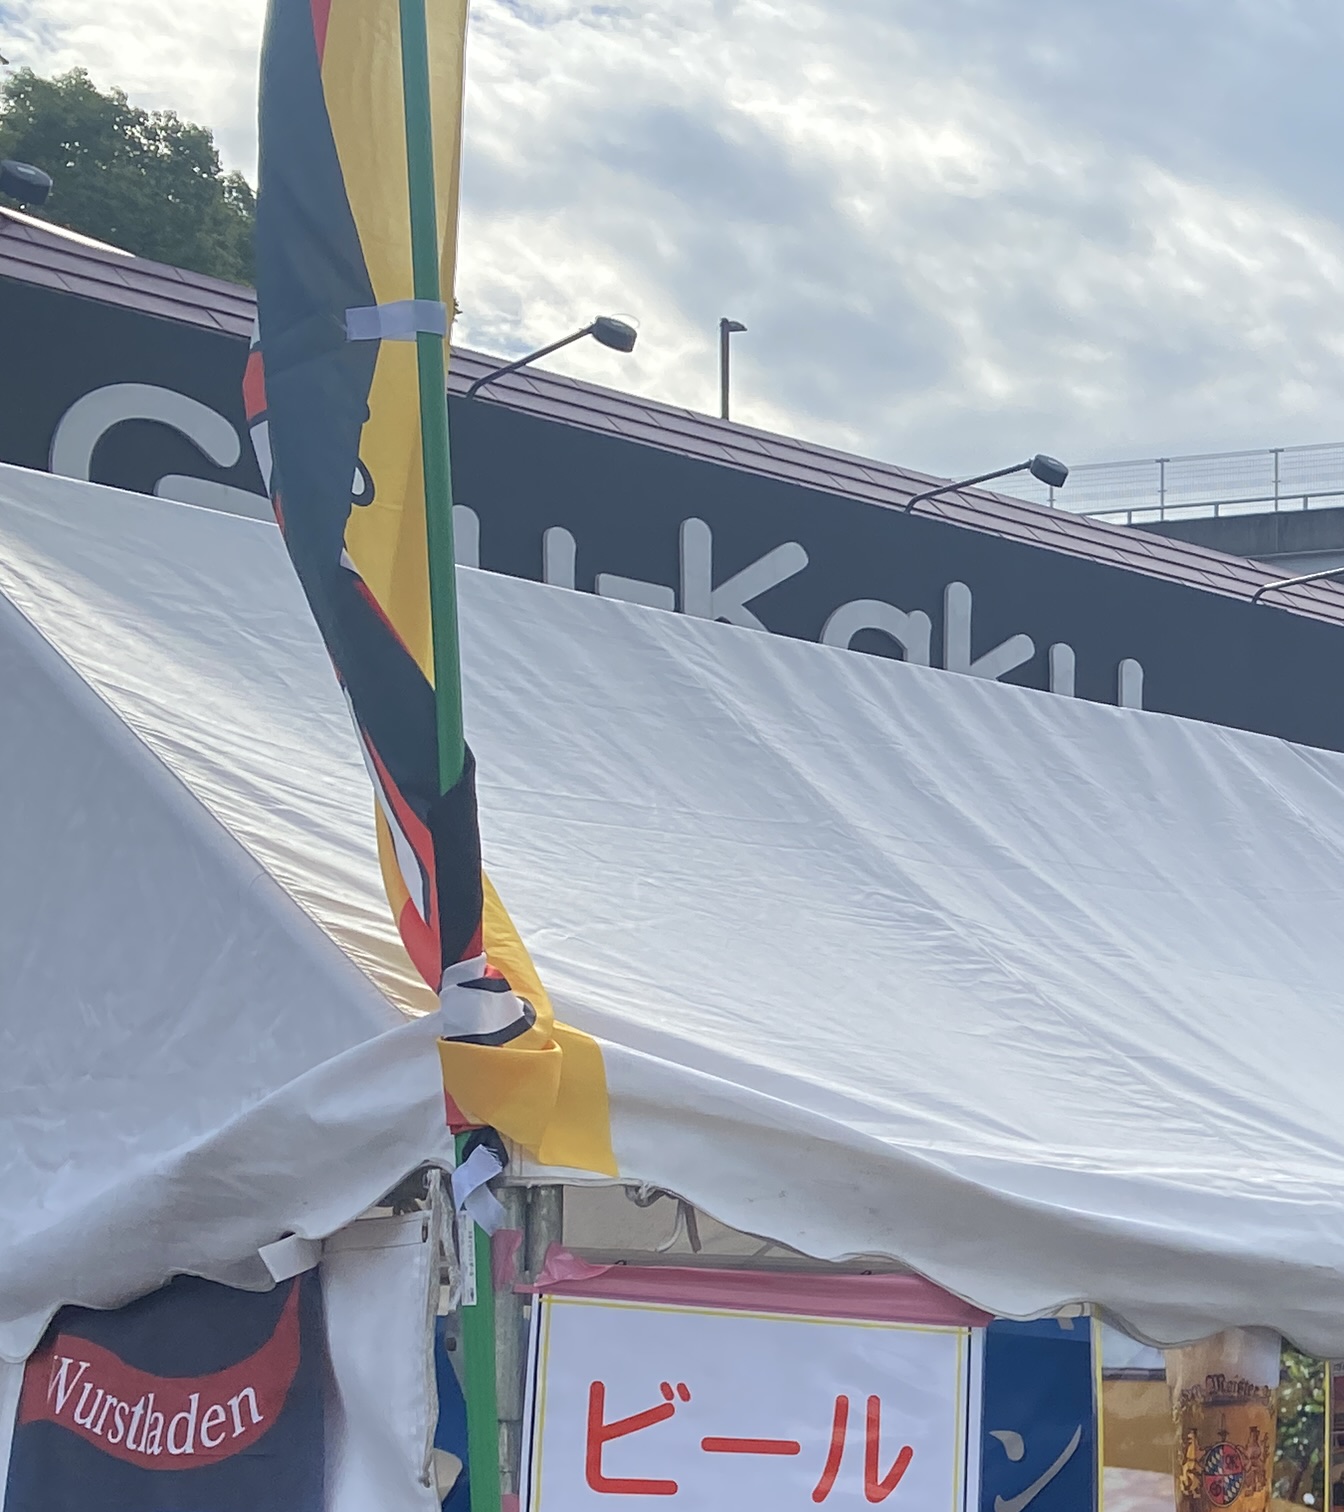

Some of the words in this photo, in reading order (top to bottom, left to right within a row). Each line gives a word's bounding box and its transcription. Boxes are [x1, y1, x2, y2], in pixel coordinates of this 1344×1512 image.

[48, 1355, 264, 1456] Wurstladen
[586, 1380, 913, 1503] ビール
